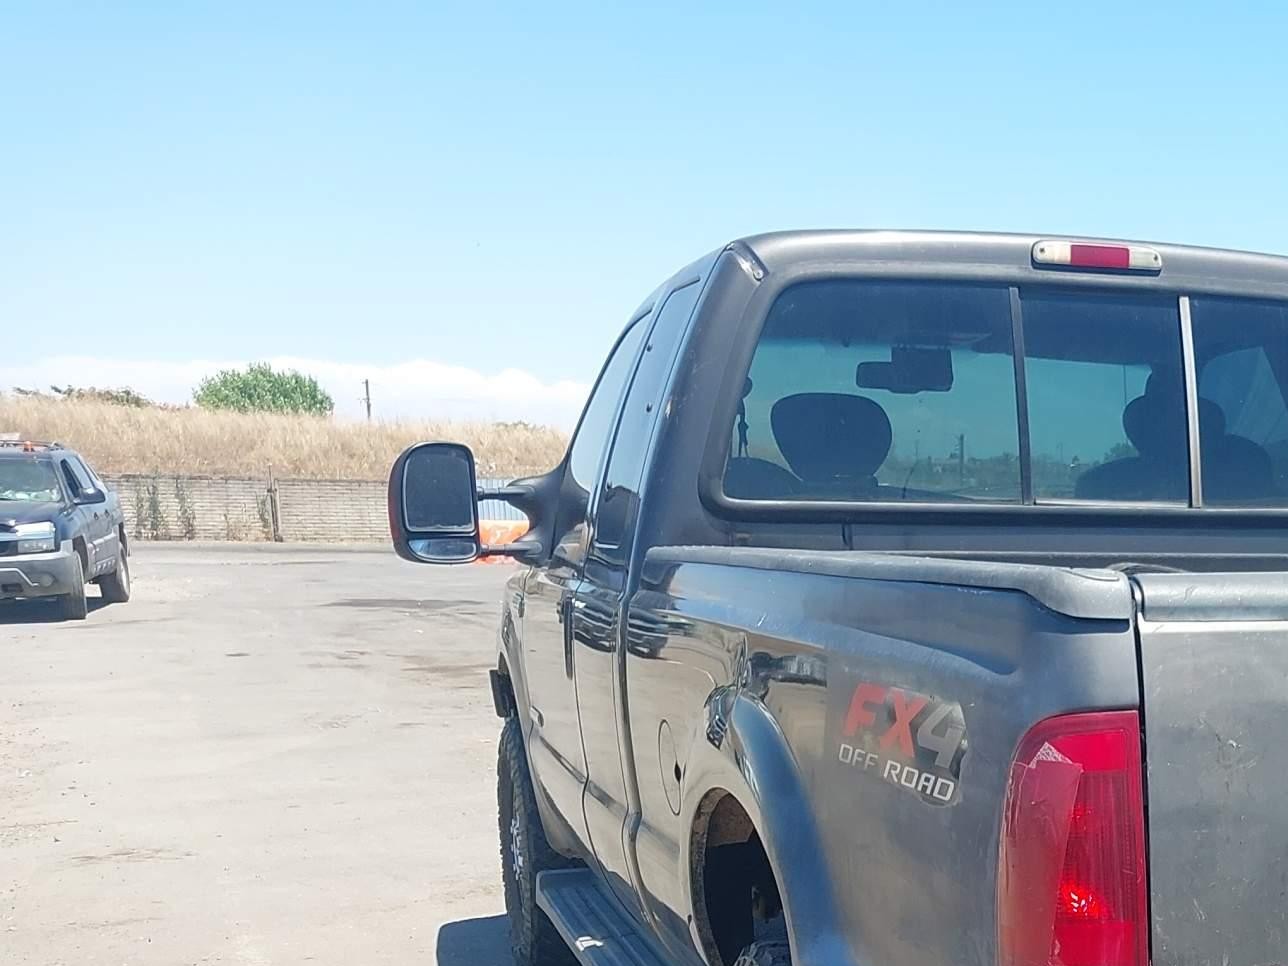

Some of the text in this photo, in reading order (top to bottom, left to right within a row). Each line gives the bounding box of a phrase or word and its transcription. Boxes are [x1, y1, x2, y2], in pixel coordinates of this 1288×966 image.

[841, 681, 966, 768] FX4
[838, 744, 955, 801] OFF ROAD
